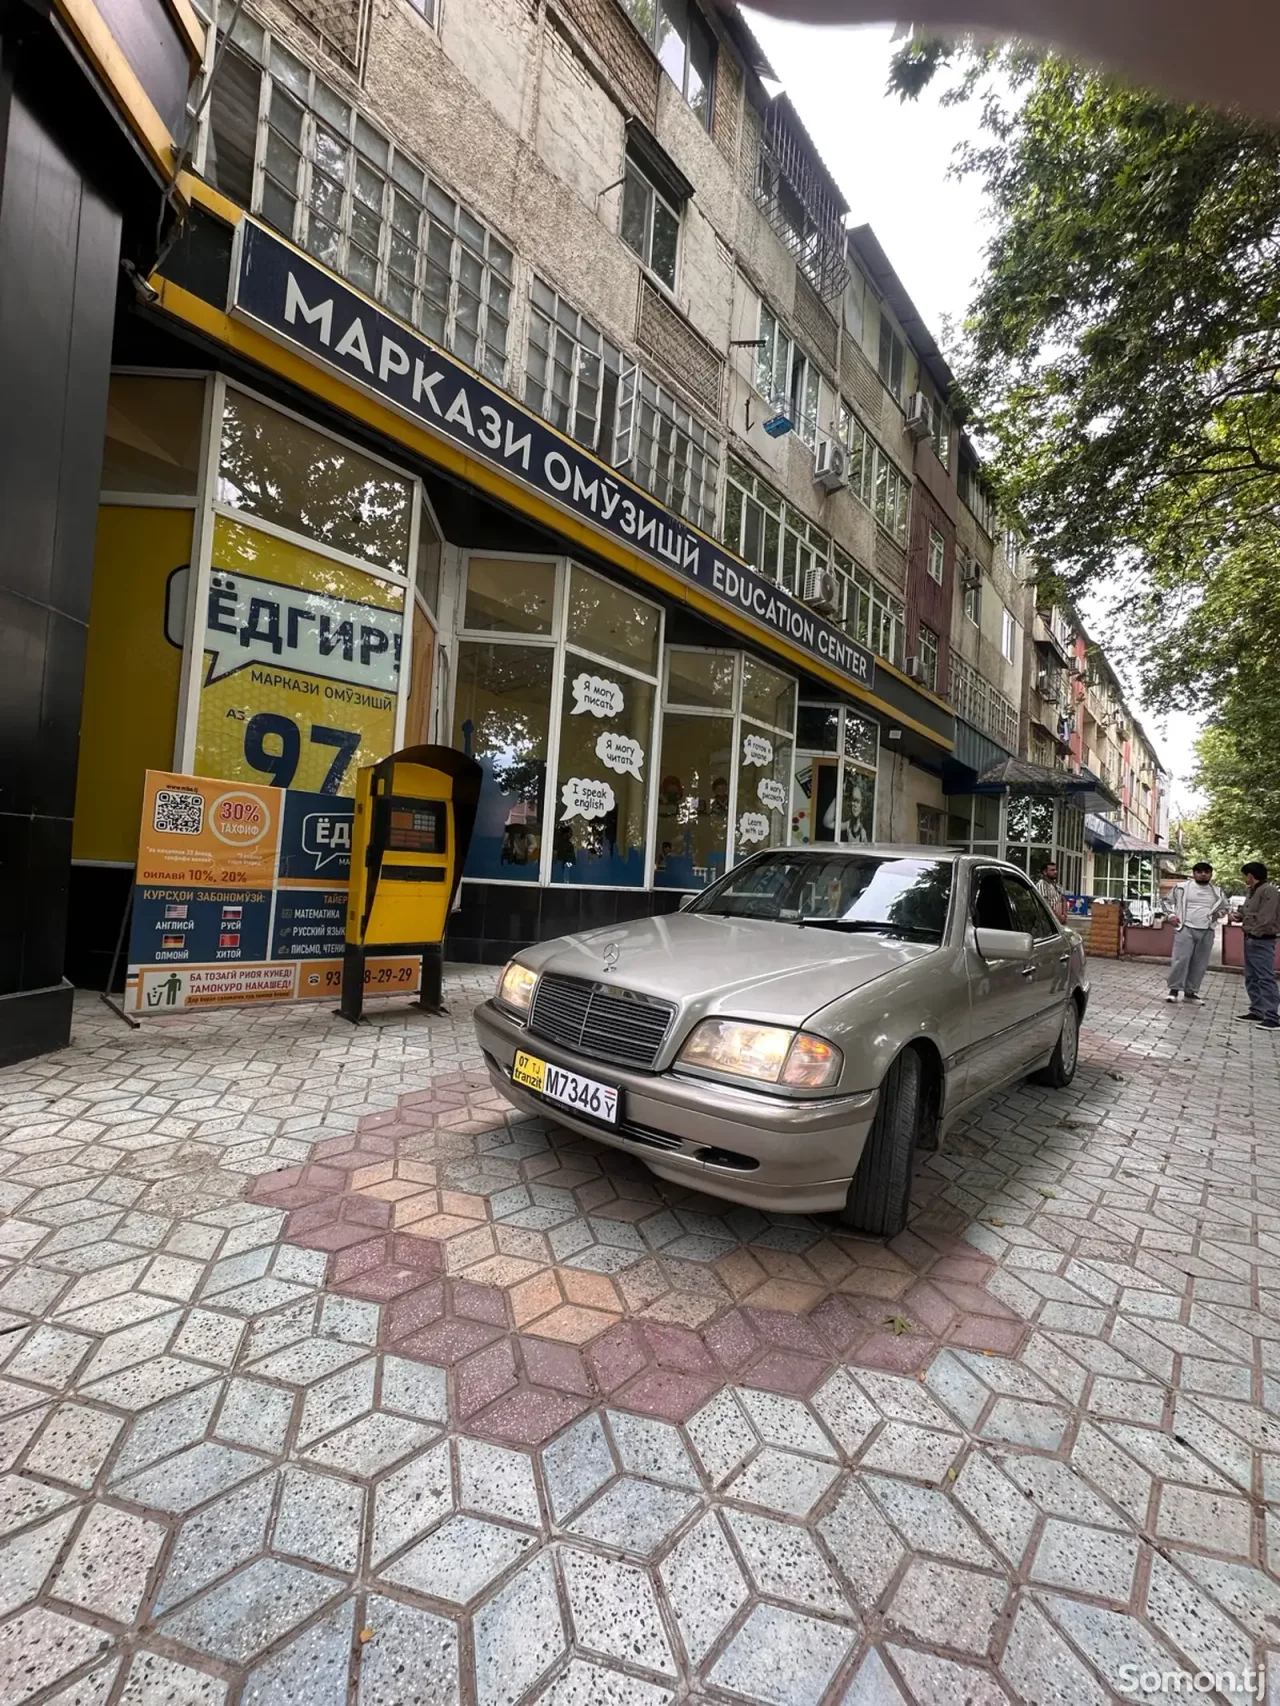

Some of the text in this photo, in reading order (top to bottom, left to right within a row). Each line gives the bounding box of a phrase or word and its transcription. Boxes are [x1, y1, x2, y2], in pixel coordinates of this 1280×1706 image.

[284, 271, 699, 575] МАРКАЗИ ОМӮЗИШӢ
[207, 577, 400, 673] ЁДГИР!
[713, 559, 867, 679] EDUCATION CENTER
[251, 670, 392, 711] МАРКАЗИ ОМӮЗИШӢ
[583, 681, 615, 701] Я могу
[584, 694, 614, 711] писать
[244, 713, 361, 794] 97
[606, 740, 635, 757] Я могу
[607, 752, 634, 765] читать
[573, 784, 607, 799] I speak
[222, 802, 260, 822] 30%
[574, 797, 604, 811] english
[220, 823, 259, 835] ТАХФИФ
[316, 818, 351, 848] ЁД
[188, 869, 217, 883] 10%,
[221, 871, 248, 883] 20%
[294, 908, 340, 919] МАТЕМАТИКА
[292, 924, 325, 937] РУССКИЙ
[291, 943, 346, 955] ПИСЬМО, ЧТЕНИ
[190, 973, 202, 981] БА
[239, 971, 262, 979] РИОЯ
[264, 969, 292, 978] КУНЕД!
[325, 967, 412, 986] 93 8-29-29
[190, 980, 291, 993] ТАМОКУРО НАКАШЕД!
[518, 1055, 541, 1074] 07 TJ
[514, 1068, 542, 1090] tranzit
[546, 1067, 614, 1118] M7346 Y
